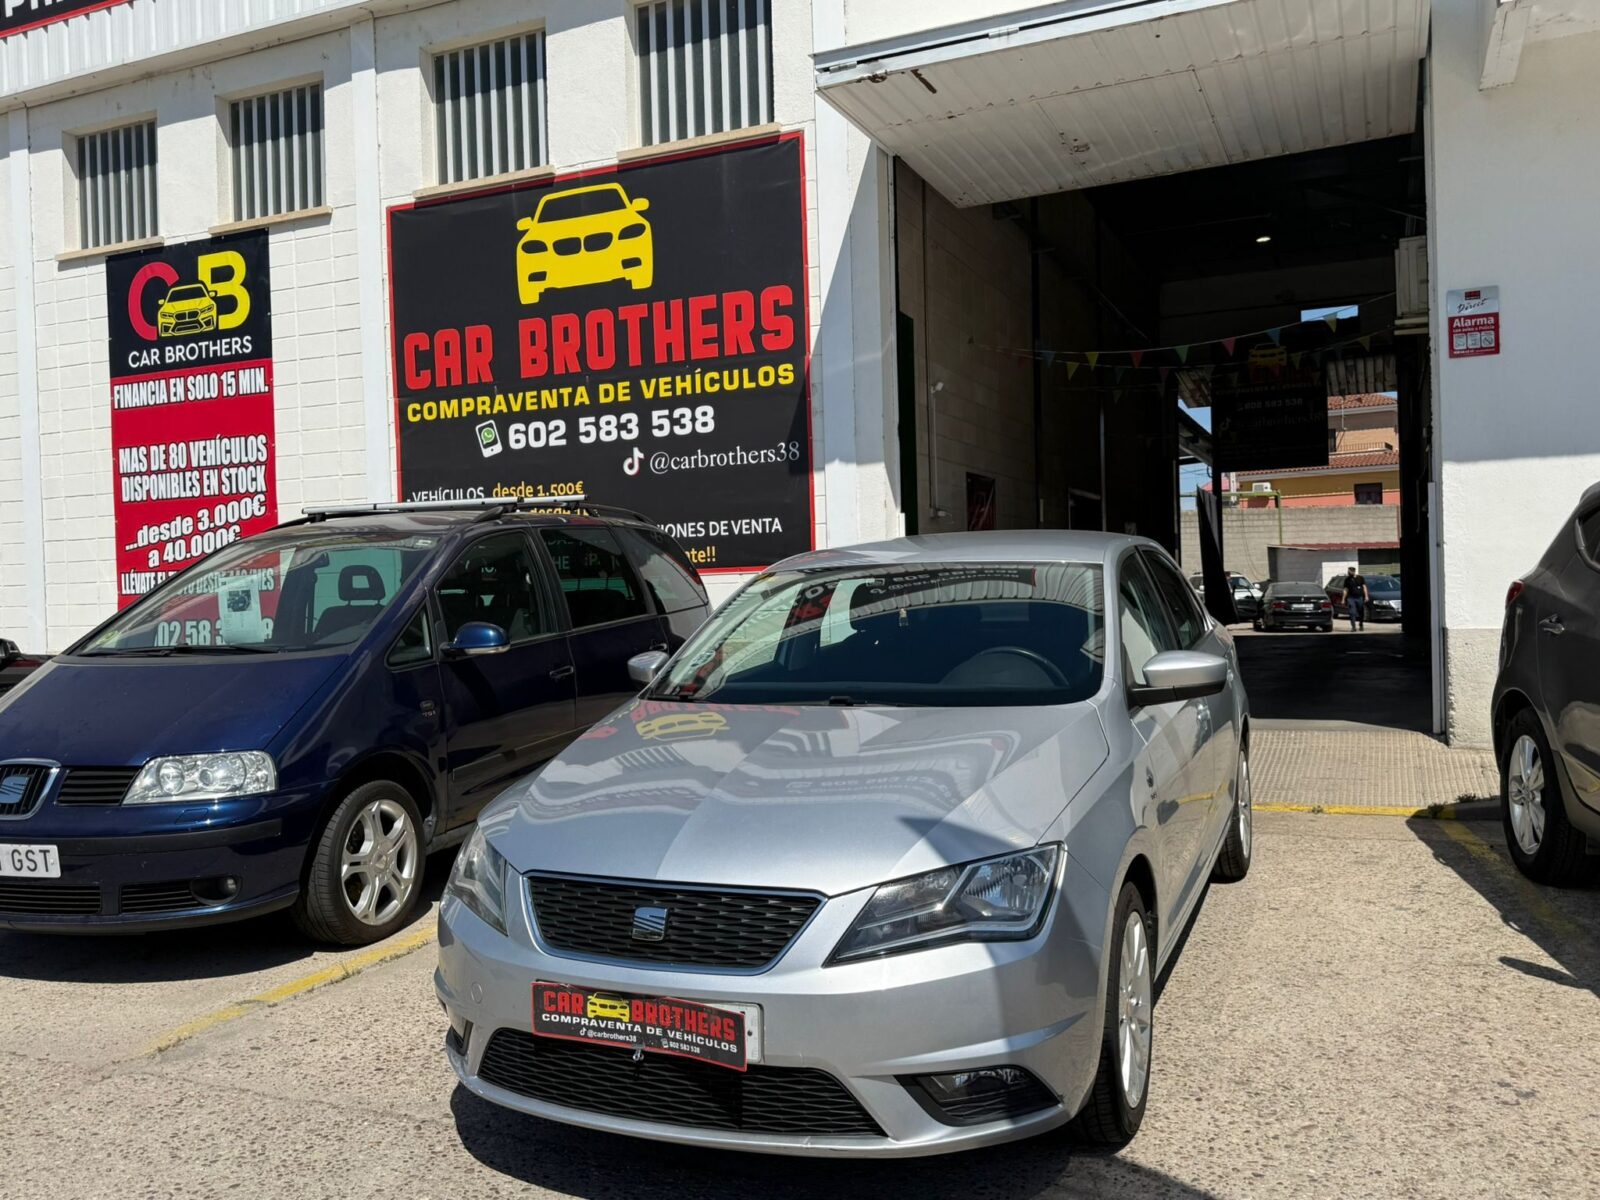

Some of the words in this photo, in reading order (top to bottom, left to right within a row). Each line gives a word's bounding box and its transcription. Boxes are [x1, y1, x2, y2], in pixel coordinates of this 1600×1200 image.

[403, 324, 494, 390] CAR
[518, 284, 794, 379] BROTHERS
[1453, 316, 1495, 328] Alarma
[128, 348, 161, 368] CAR
[165, 335, 252, 363] BROTHERS
[113, 379, 168, 410] FINANCIA
[170, 377, 185, 402] EN
[187, 373, 218, 401] SOLO
[220, 371, 236, 397] 15
[239, 367, 269, 395] MIN.
[407, 385, 590, 422] COMPRAVENTA
[599, 379, 631, 402] DE
[640, 363, 795, 400] VEHÍCULOS
[508, 419, 567, 450] 602
[578, 412, 639, 444] 583
[651, 405, 715, 437] 538
[119, 445, 147, 474] MAS
[151, 445, 167, 471] DE
[169, 442, 187, 470] 80
[190, 434, 268, 467] VEHÍCULOS
[650, 441, 800, 474] @carbrothers38
[121, 471, 200, 502] DISPONIBLES
[203, 469, 219, 496] EN
[221, 465, 266, 495] STOCK
[493, 481, 534, 497] desde
[537, 480, 584, 496] 1.500€
[197, 494, 266, 531] 3.000€
[709, 520, 729, 537] DE
[730, 517, 783, 535] VENTA
[148, 549, 160, 568] a
[163, 525, 241, 563] 40.000€
[11, 848, 51, 873] GST
[542, 1013, 642, 1033] COMPRAVENTA
[646, 1026, 663, 1037] DE
[667, 1030, 738, 1053] VEHÍCULOS
[543, 990, 584, 1016] CAR
[631, 1000, 736, 1041] BROTHERS
[587, 1029, 637, 1043] @carbrothers38
